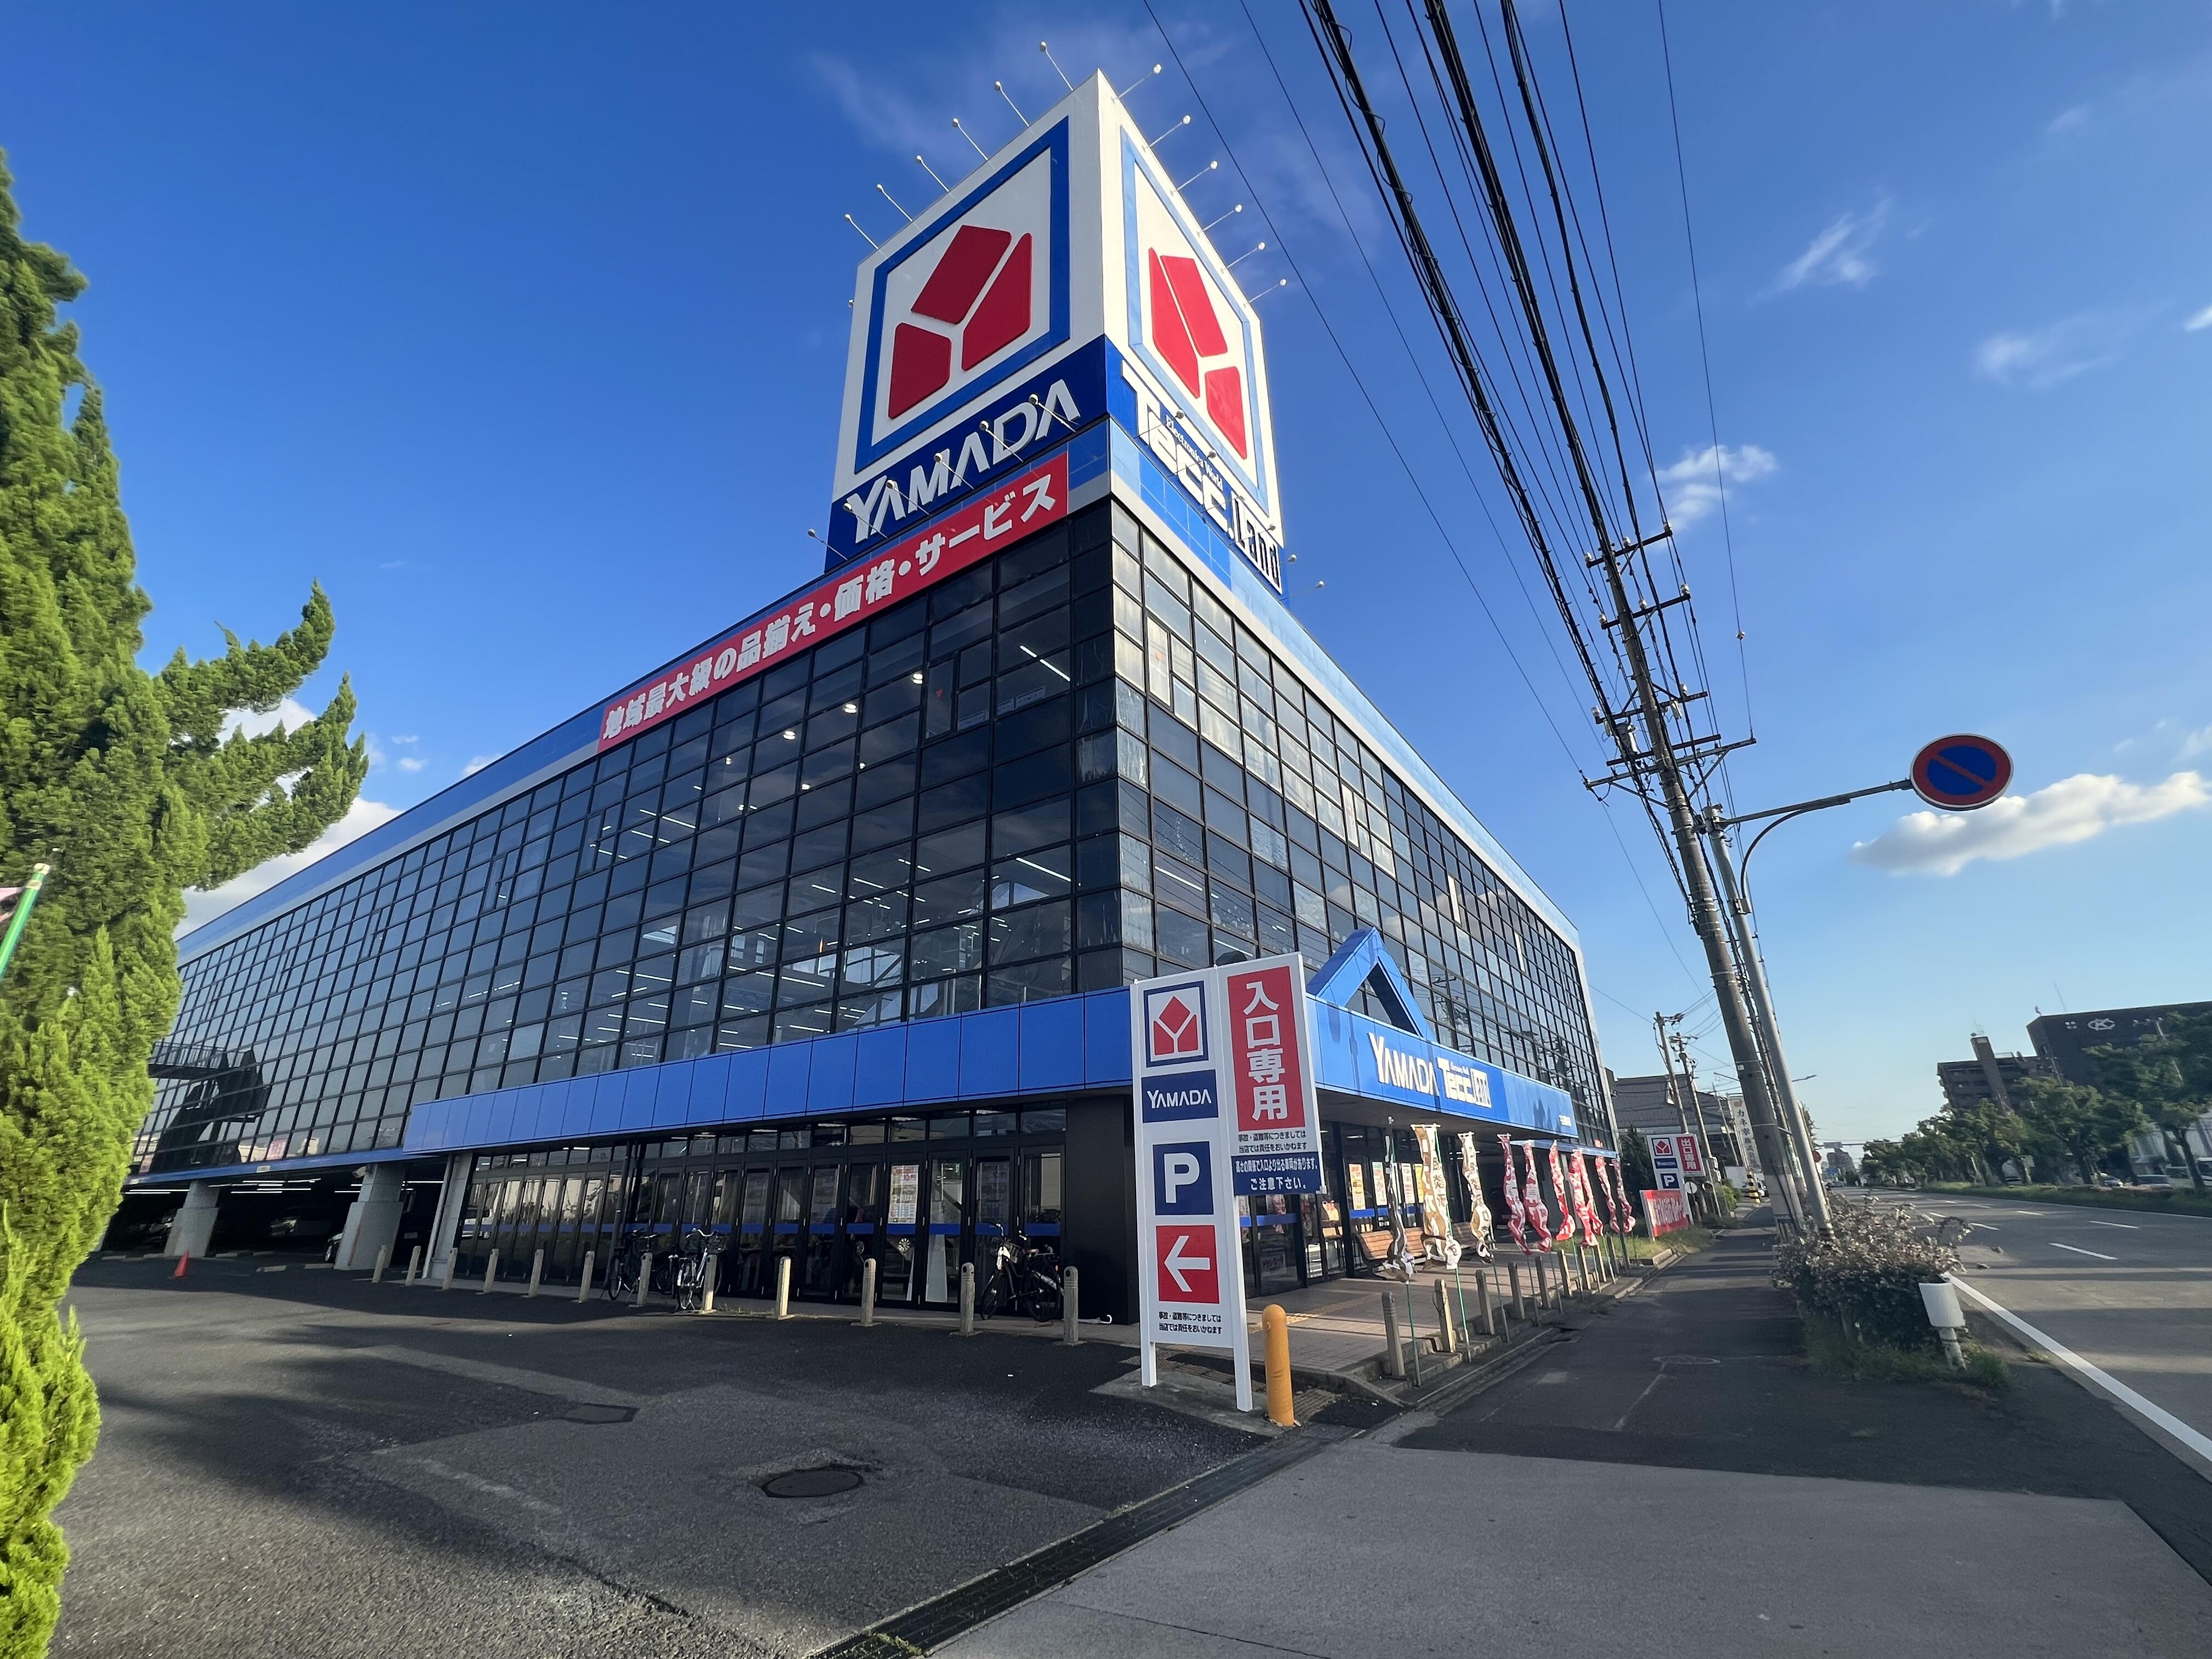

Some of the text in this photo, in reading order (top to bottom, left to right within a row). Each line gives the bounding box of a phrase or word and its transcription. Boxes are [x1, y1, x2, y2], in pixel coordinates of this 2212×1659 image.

[847, 379, 1081, 544] YAMADA
[1166, 414, 1223, 491] Electronics World
[603, 474, 1056, 740] 地域最大級の品揃え・価格・サービス
[1243, 981, 1288, 1121] 入口専用
[1368, 1032, 1439, 1097] YAMADA
[1147, 1089, 1211, 1109] YAMADA
[1238, 1131, 1306, 1142] 事故・盗難等につきましては
[1239, 1142, 1307, 1153] 当店では責任をおいかねます
[1681, 1138, 1696, 1169] 出口専用
[1164, 1152, 1200, 1204] P
[1250, 1177, 1307, 1190] ご注意下さい。
[1663, 1175, 1675, 1187] P
[1159, 1323, 1222, 1334] 当店では責任をおいかねます
